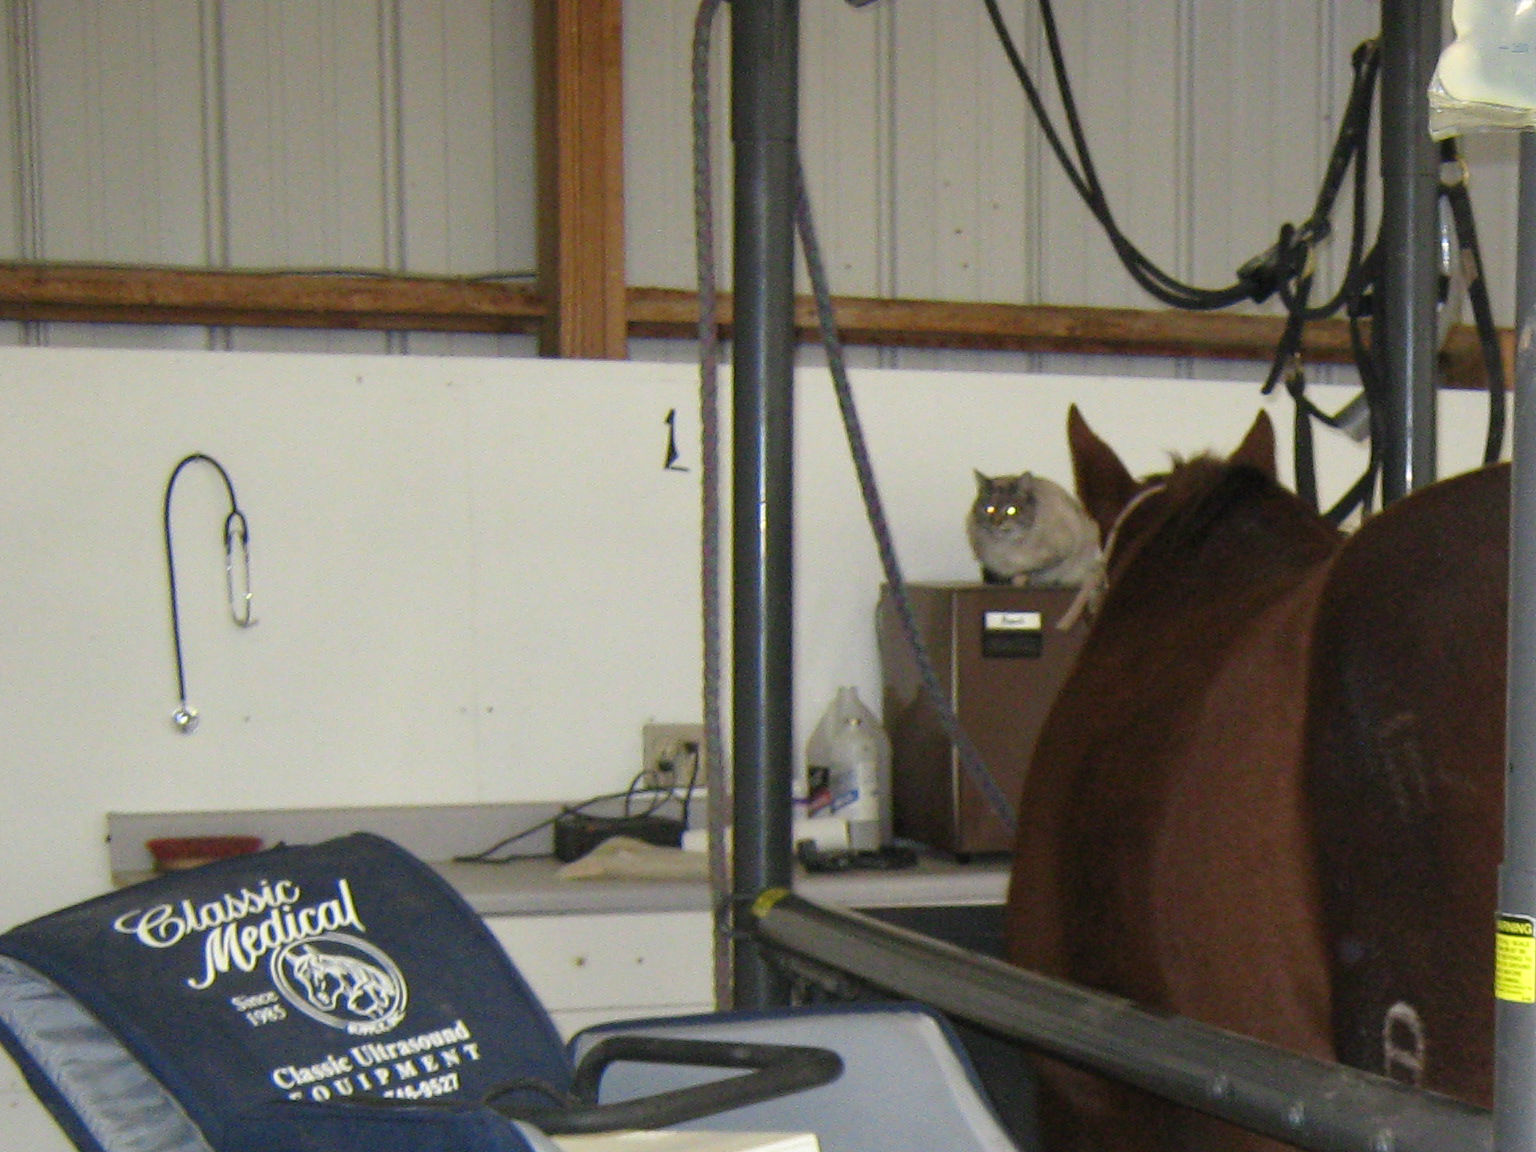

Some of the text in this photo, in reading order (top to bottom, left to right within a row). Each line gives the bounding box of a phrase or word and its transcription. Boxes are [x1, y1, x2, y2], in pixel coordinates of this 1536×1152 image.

[114, 879, 300, 949] Classic
[187, 878, 367, 990] Medical
[272, 1055, 353, 1090] Classic
[350, 1019, 472, 1067] Ultrasound
